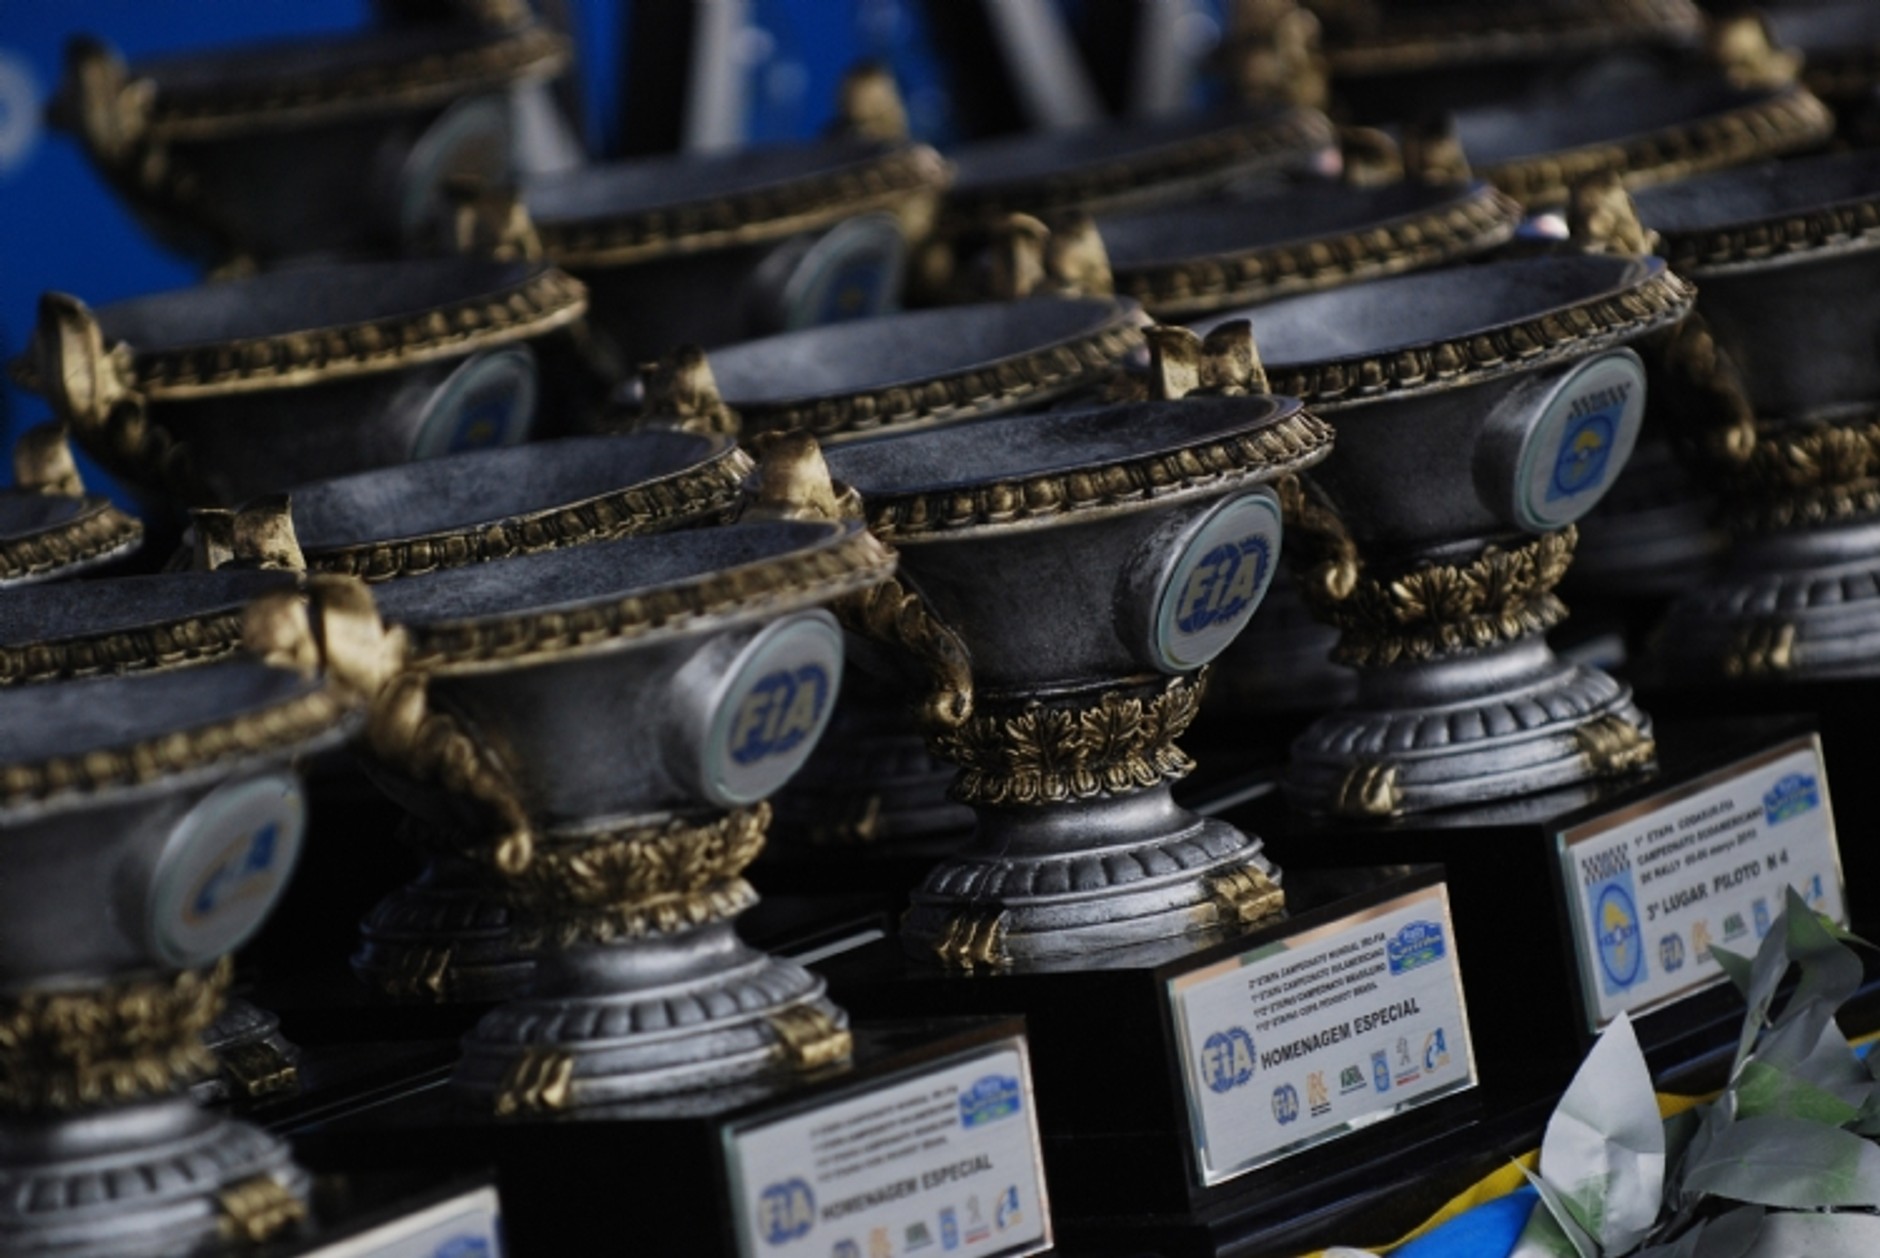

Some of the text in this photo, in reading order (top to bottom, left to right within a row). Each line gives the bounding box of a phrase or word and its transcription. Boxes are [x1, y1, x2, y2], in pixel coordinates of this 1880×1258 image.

[1662, 882, 1708, 915] LUGAR
[1713, 861, 1761, 893] PILOTO
[1260, 1022, 1351, 1070] HOMENAGEM
[1354, 997, 1420, 1037] ESPECIAL
[821, 1177, 918, 1222] HOMENAGEM
[922, 1153, 993, 1191] ESPECIAL
